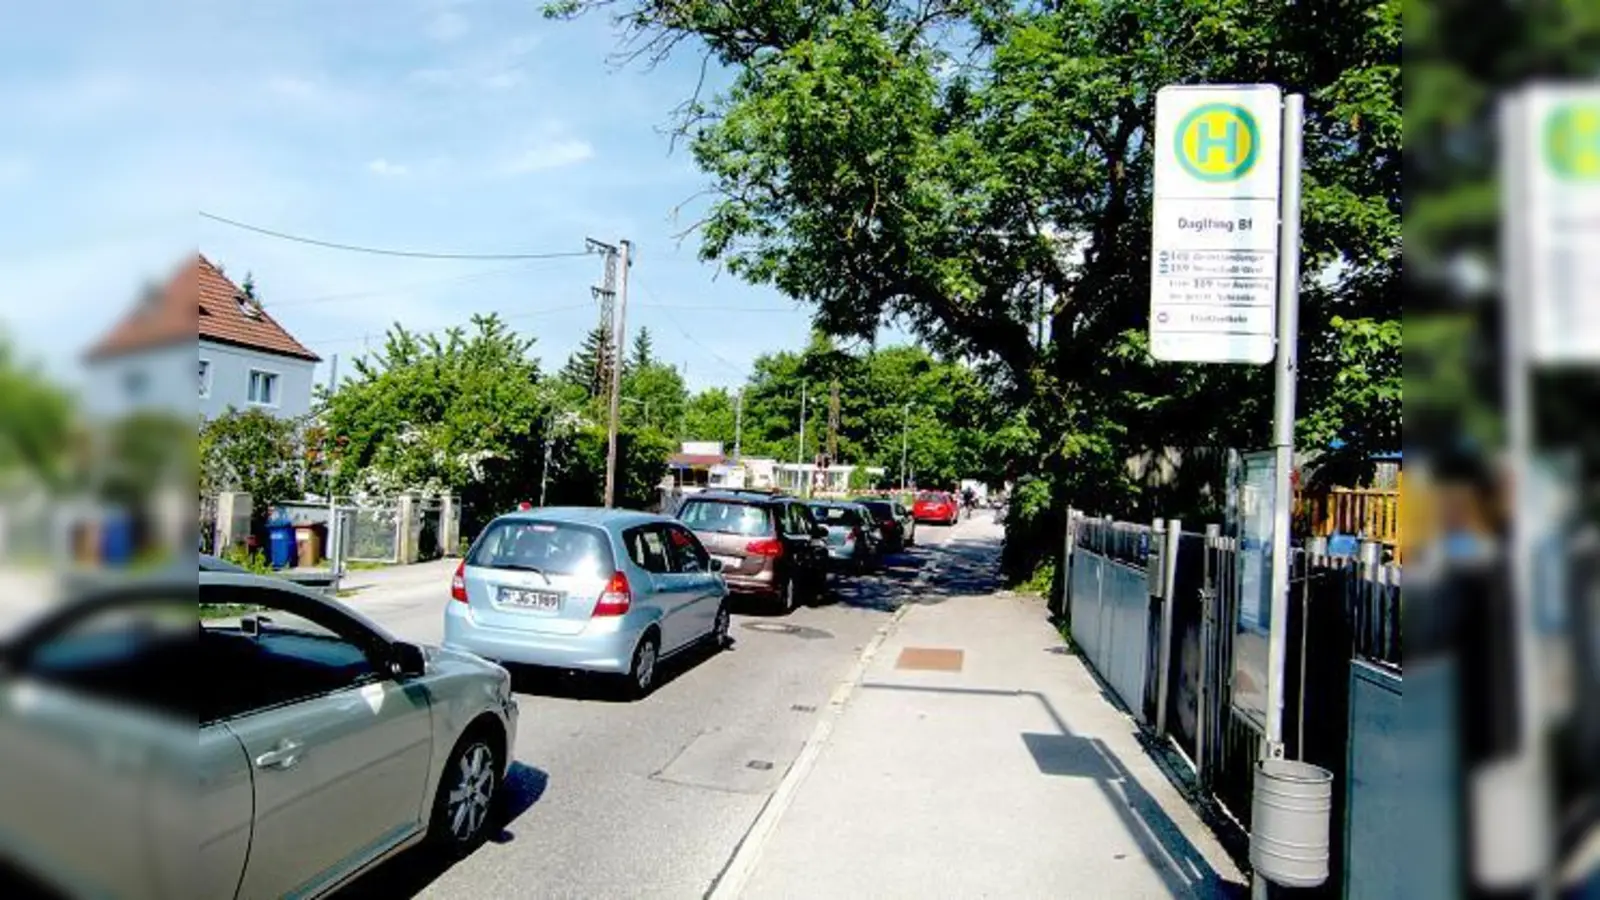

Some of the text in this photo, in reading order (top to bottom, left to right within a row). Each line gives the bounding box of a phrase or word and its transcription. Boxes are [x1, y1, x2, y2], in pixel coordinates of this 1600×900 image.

[1197, 121, 1237, 164] H
[1177, 216, 1253, 233] Daglfing Bf
